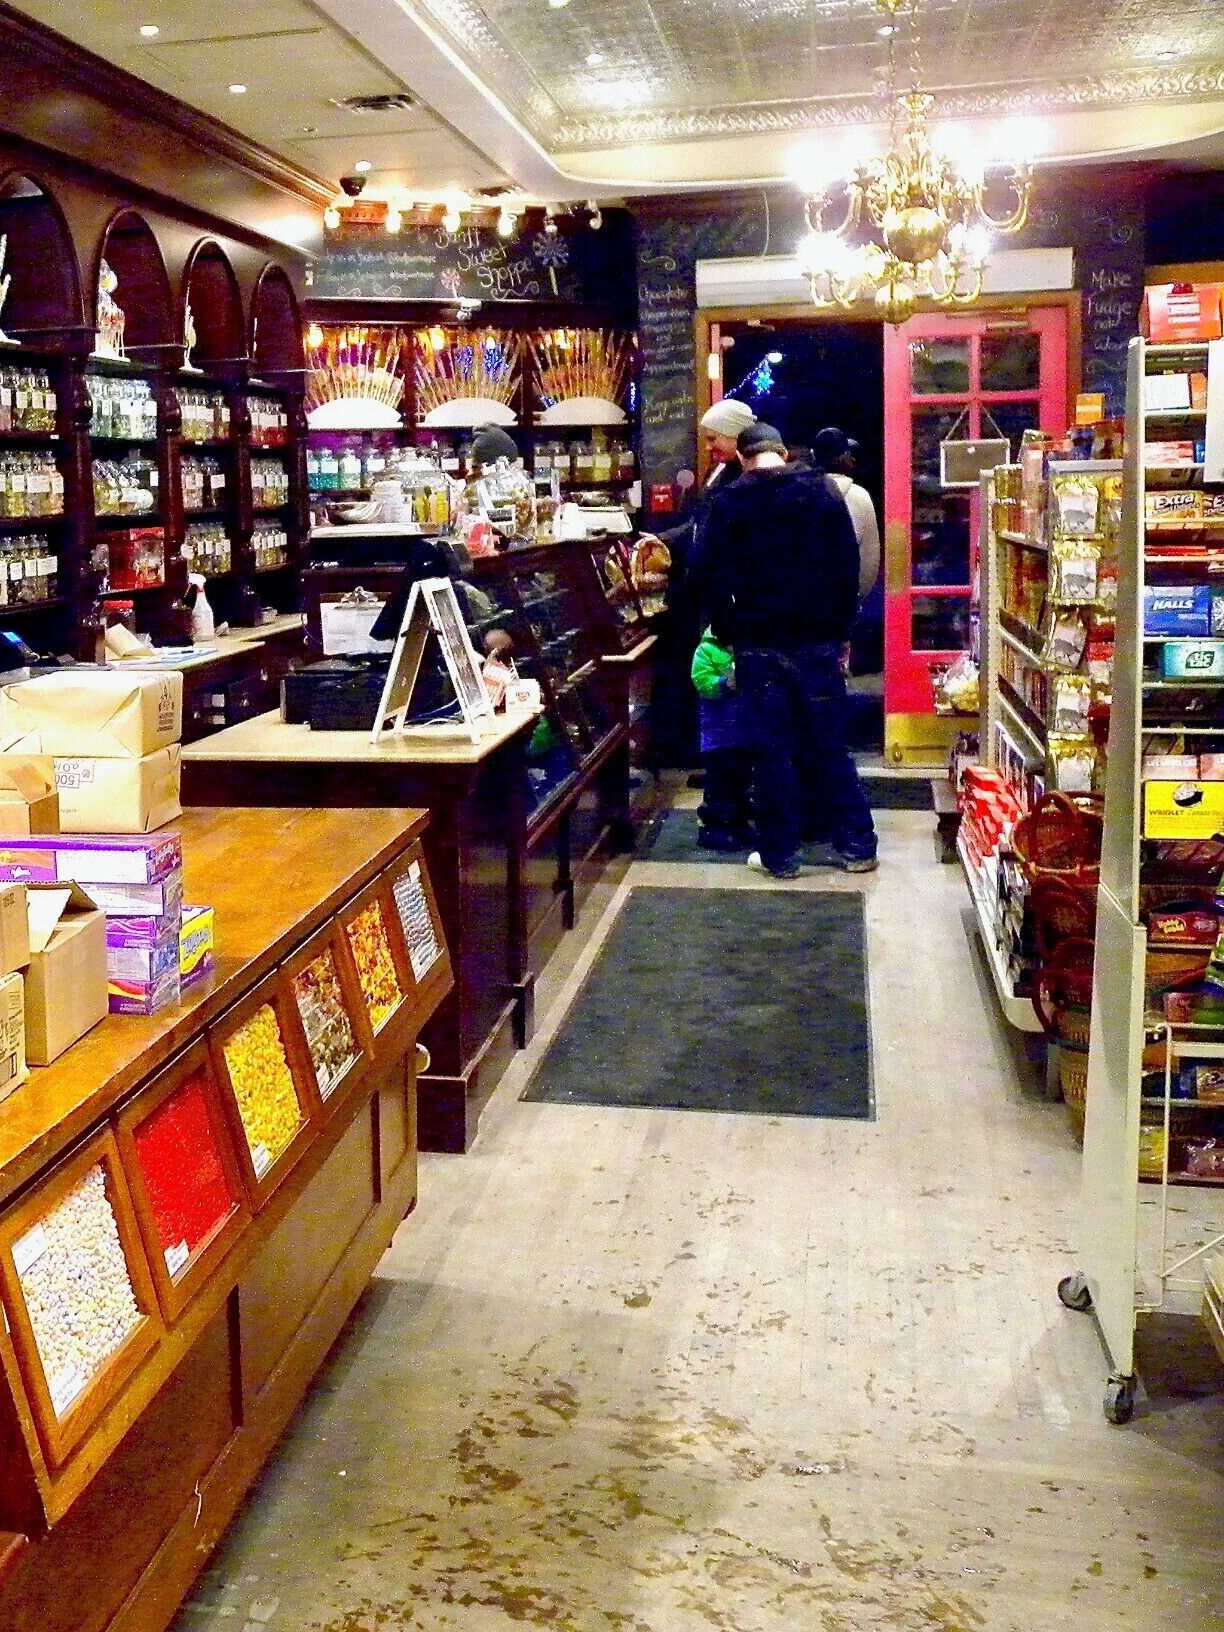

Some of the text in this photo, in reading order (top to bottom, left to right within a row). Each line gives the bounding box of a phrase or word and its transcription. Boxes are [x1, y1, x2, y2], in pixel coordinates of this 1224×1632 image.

[457, 241, 507, 271] Sweet
[1154, 491, 1196, 510] Extra
[1152, 600, 1193, 610] HALLS
